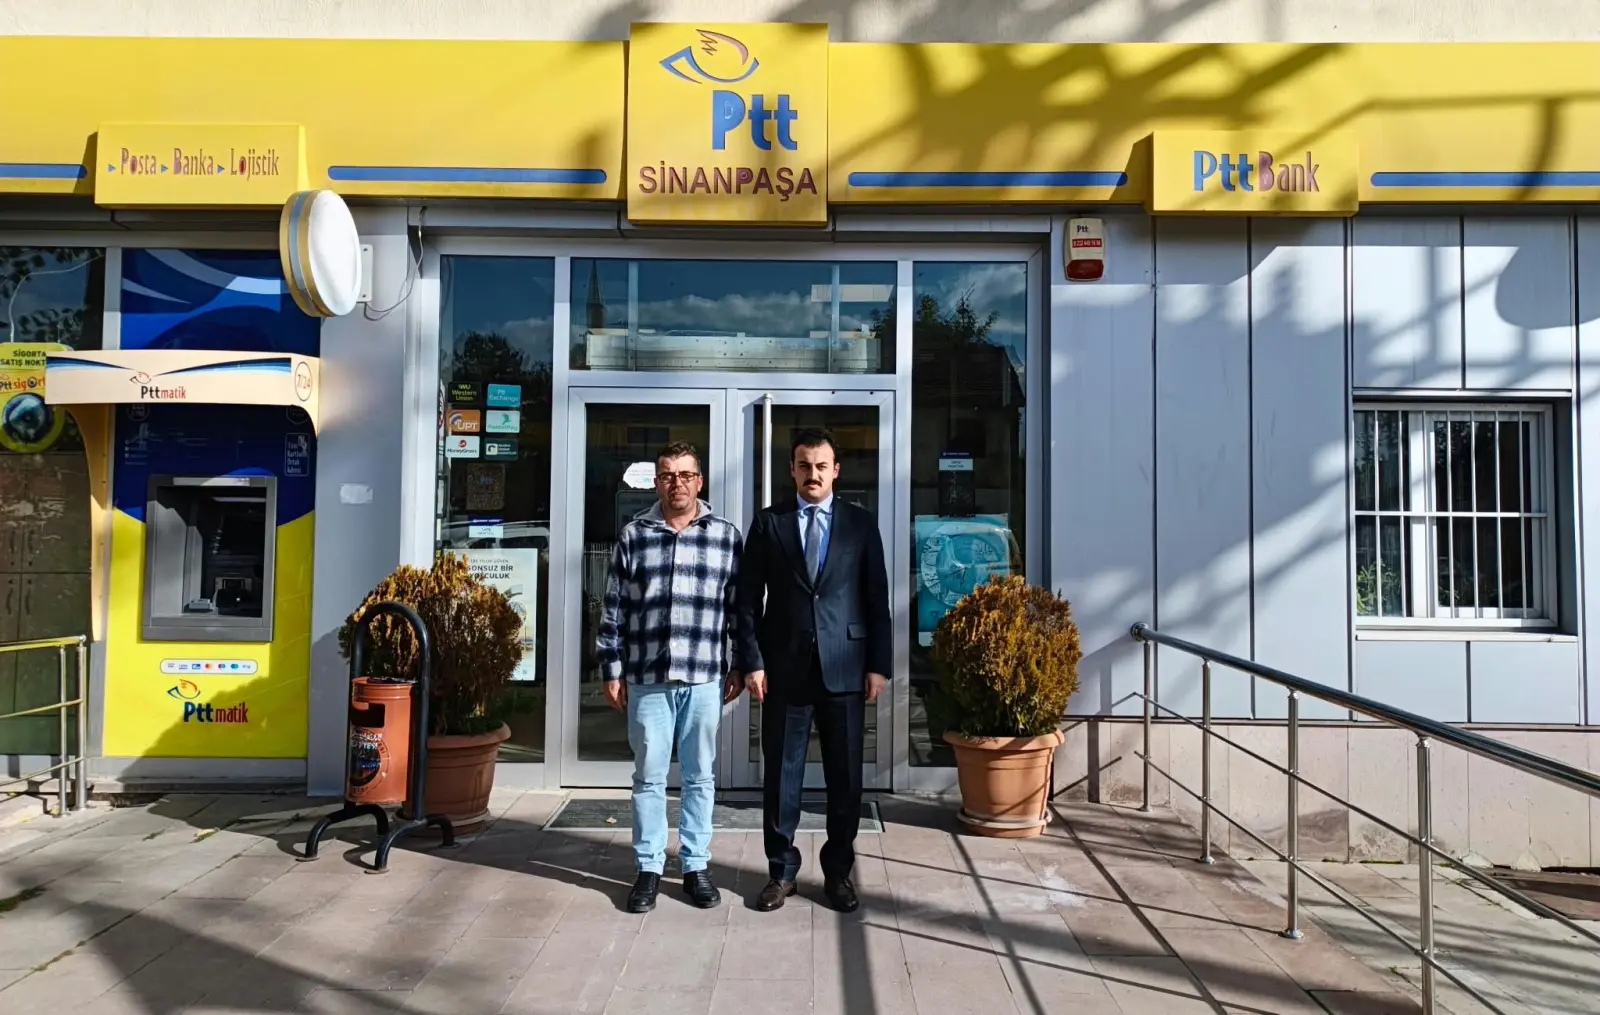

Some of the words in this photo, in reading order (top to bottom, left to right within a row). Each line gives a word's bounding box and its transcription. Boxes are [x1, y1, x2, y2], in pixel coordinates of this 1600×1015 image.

[712, 89, 798, 151] Ptt
[120, 147, 157, 176] Posta
[173, 147, 214, 176] Banka
[230, 148, 279, 182] Lojistik
[638, 160, 818, 202] SİNANPAŞA
[1076, 225, 1088, 233] Ptt
[13, 347, 46, 357] SİGORTA
[0, 359, 23, 367] SATIŞ
[25, 359, 47, 367] NOKT
[141, 385, 186, 399] Pttmatik
[457, 422, 478, 431] UPT
[500, 563, 514, 572] BİR
[183, 701, 249, 723] Pttmatik
